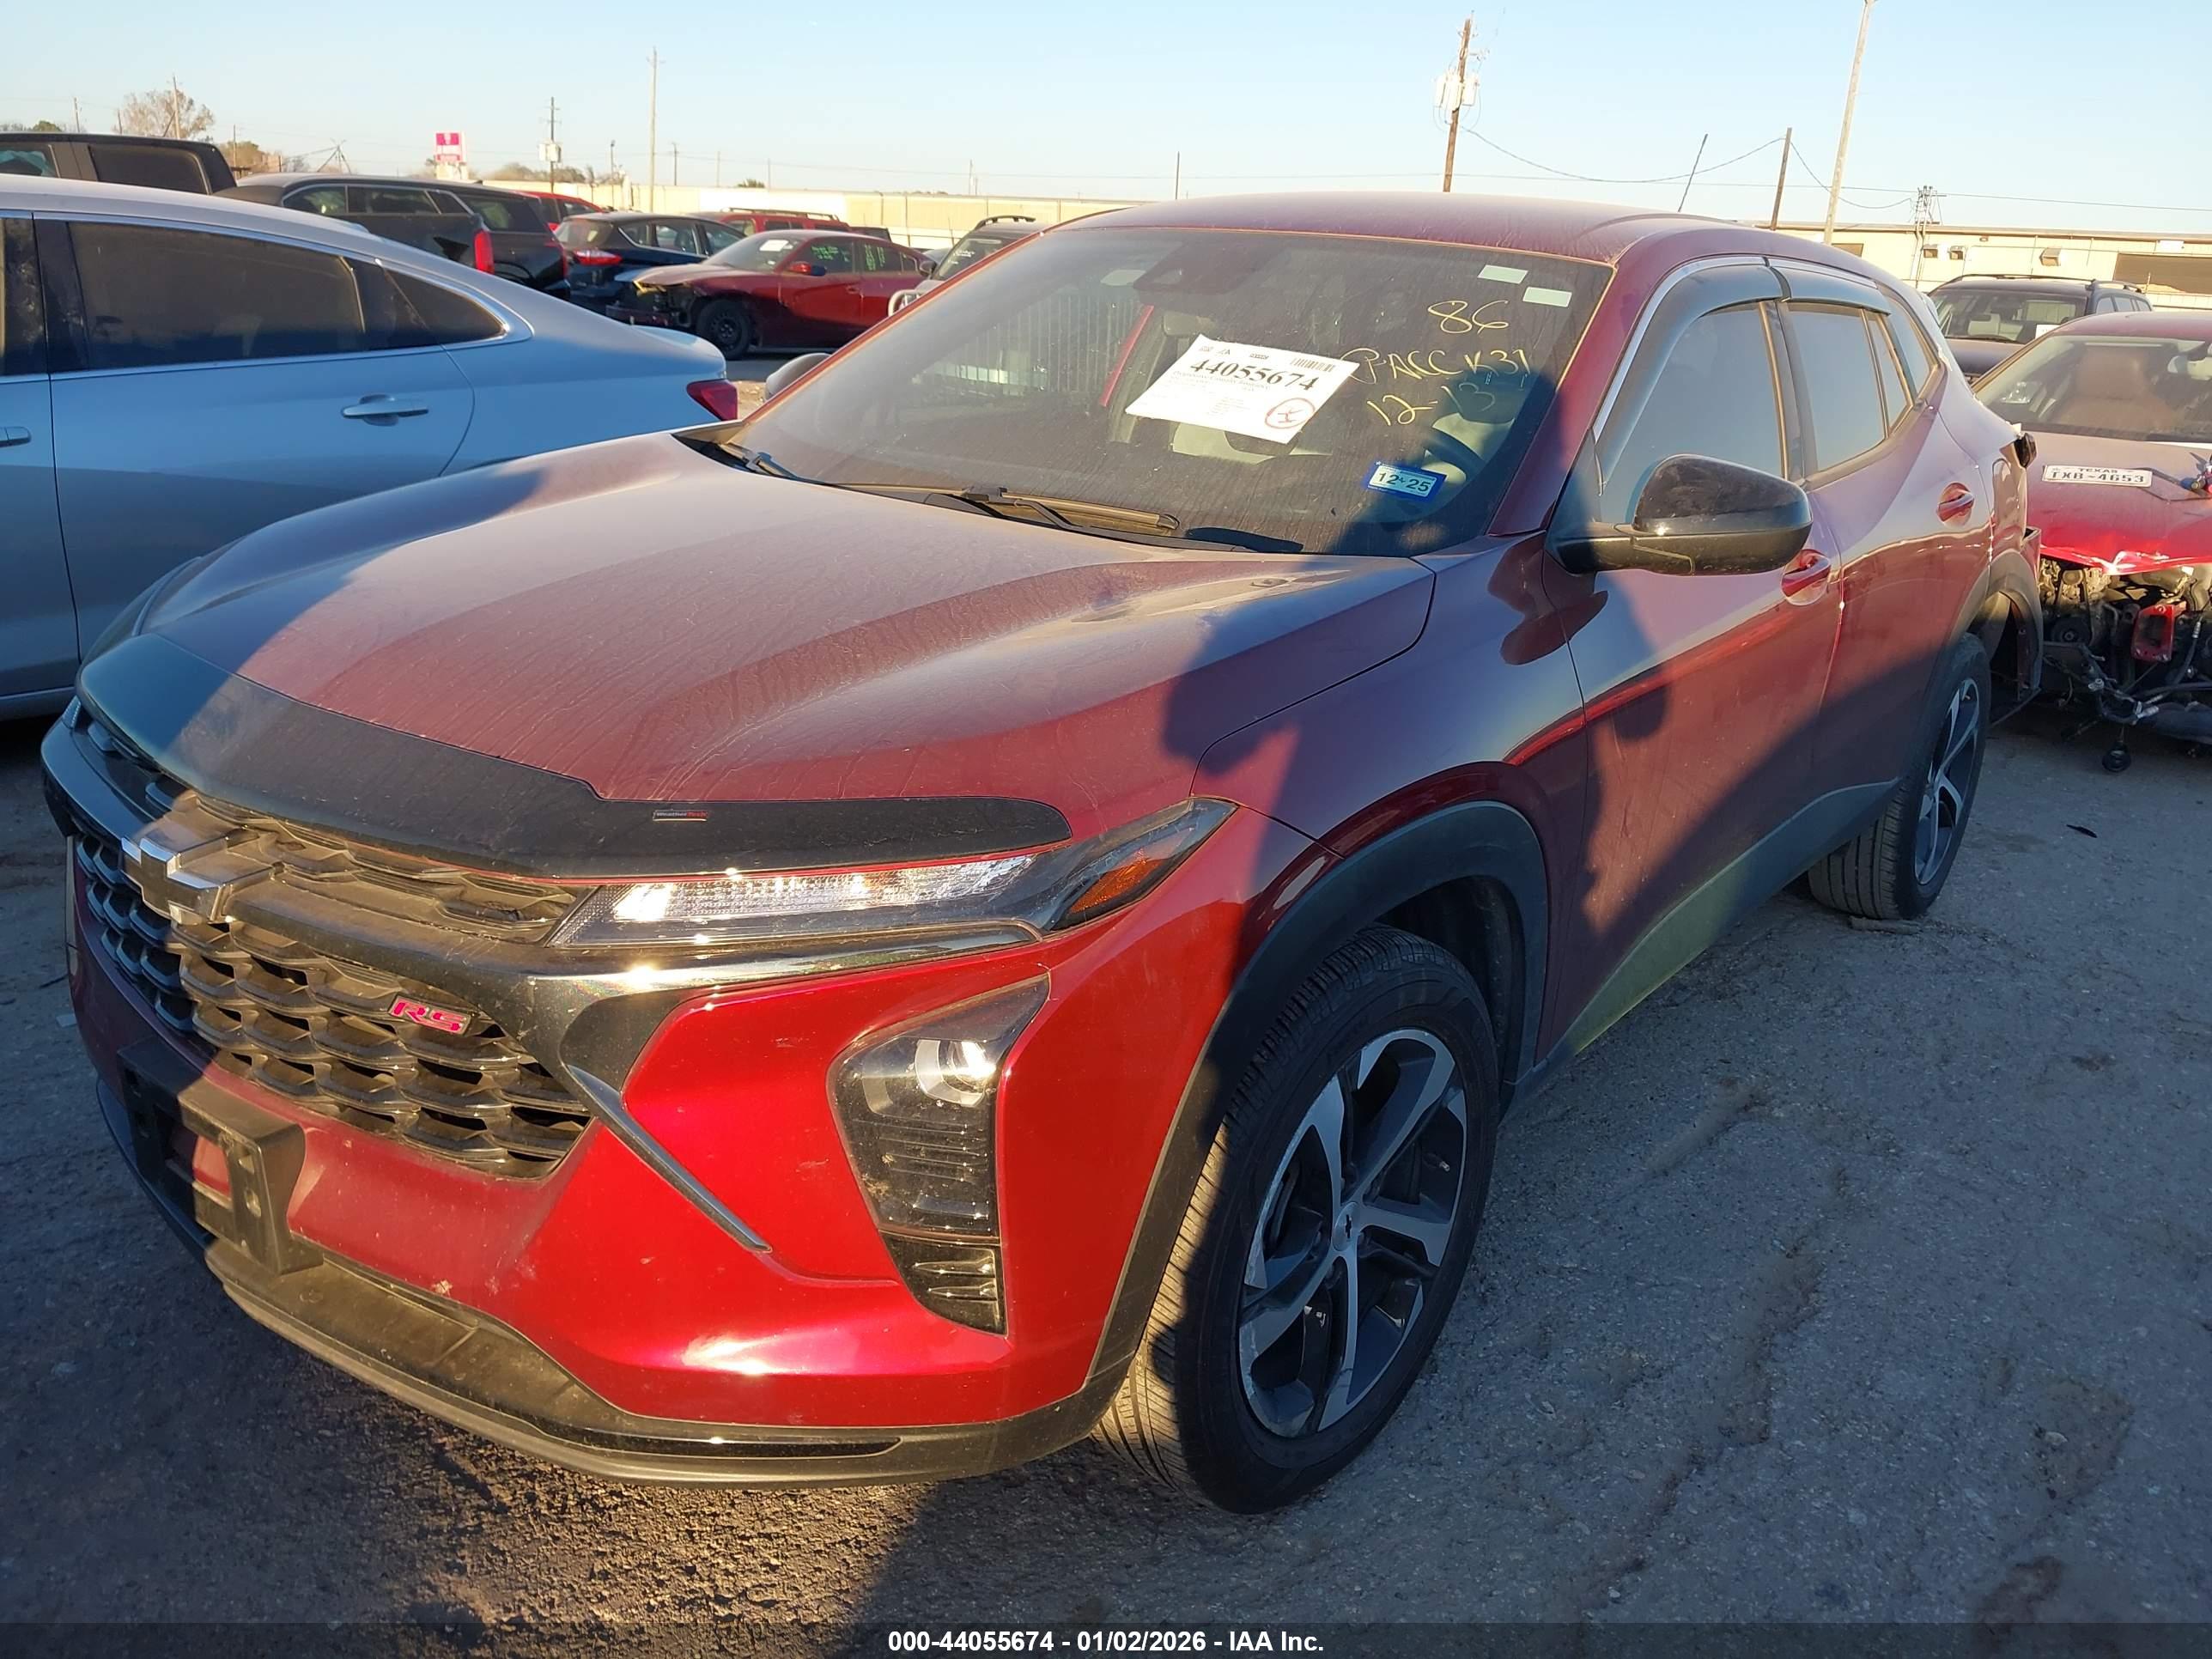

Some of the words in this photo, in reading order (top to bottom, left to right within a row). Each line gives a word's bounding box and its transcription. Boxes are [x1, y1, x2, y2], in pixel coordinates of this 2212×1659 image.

[1427, 300, 1509, 334] 86
[1190, 359, 1320, 392] 44055674
[1378, 472, 1400, 485] 12
[1406, 478, 1431, 492] 25
[390, 998, 469, 1033] RS
